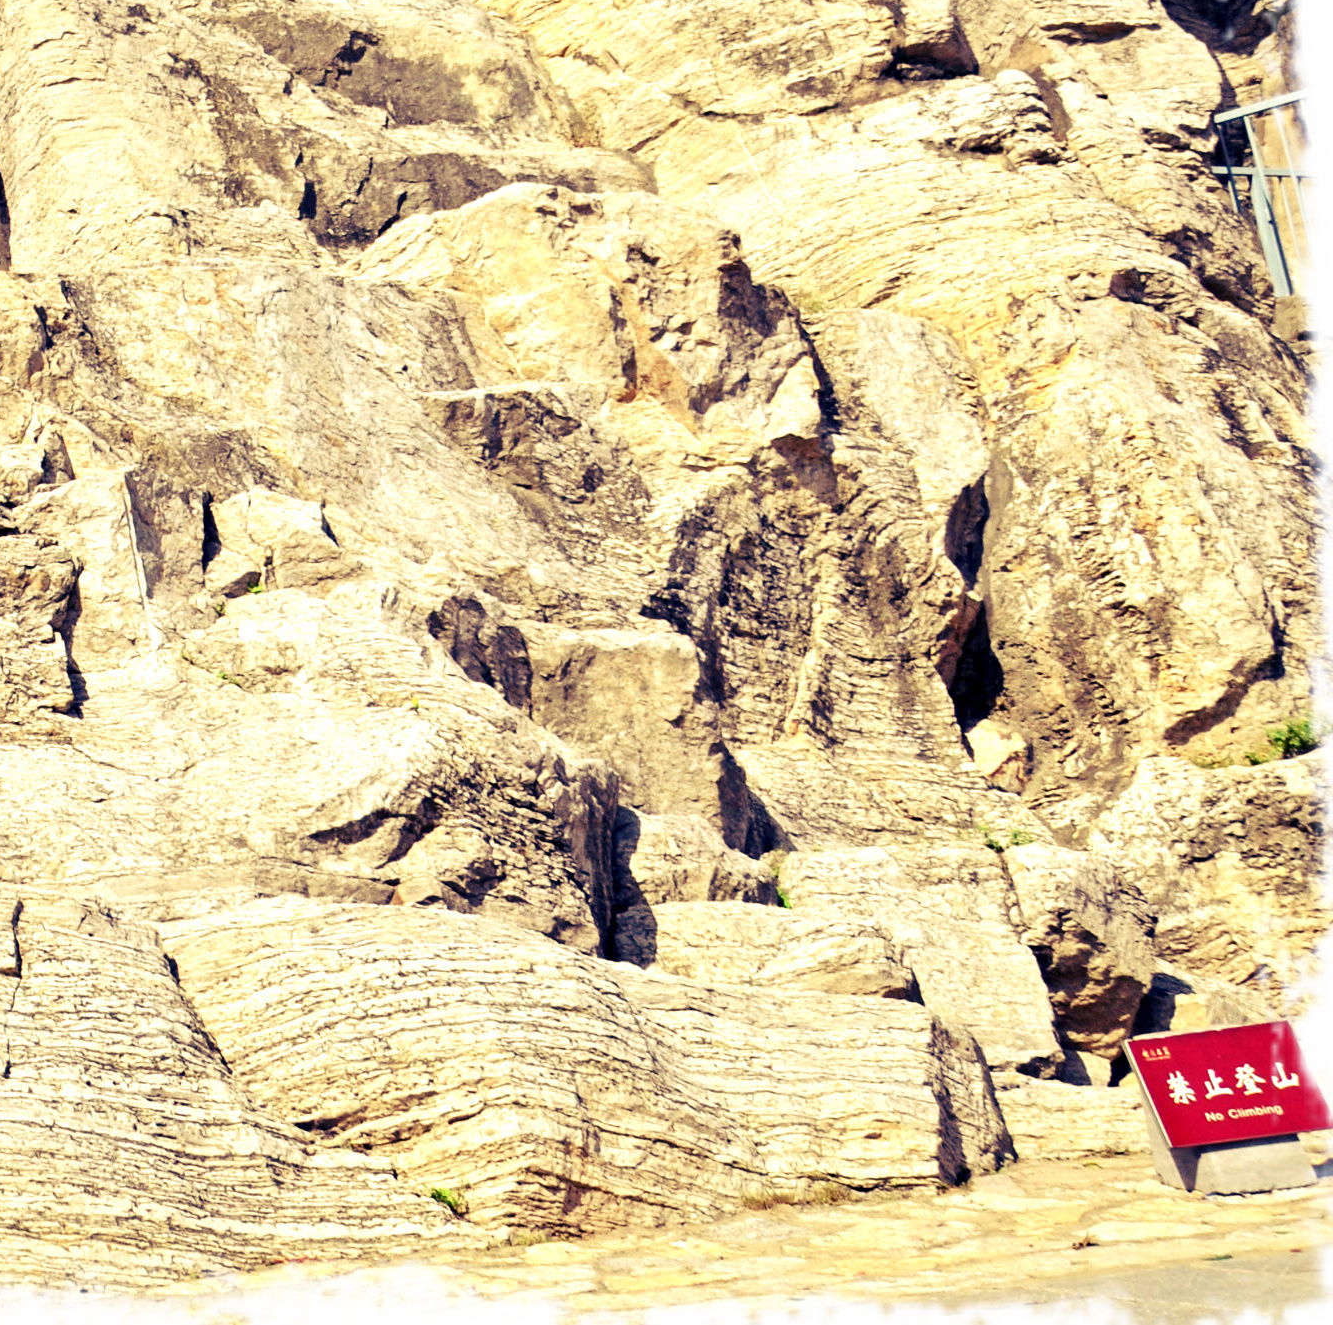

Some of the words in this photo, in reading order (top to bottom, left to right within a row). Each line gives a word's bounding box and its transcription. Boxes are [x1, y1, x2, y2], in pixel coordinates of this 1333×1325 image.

[1166, 1062, 1300, 1104] 禁止登山
[1204, 1112, 1224, 1122] No
[1228, 1104, 1284, 1120] Climbing
